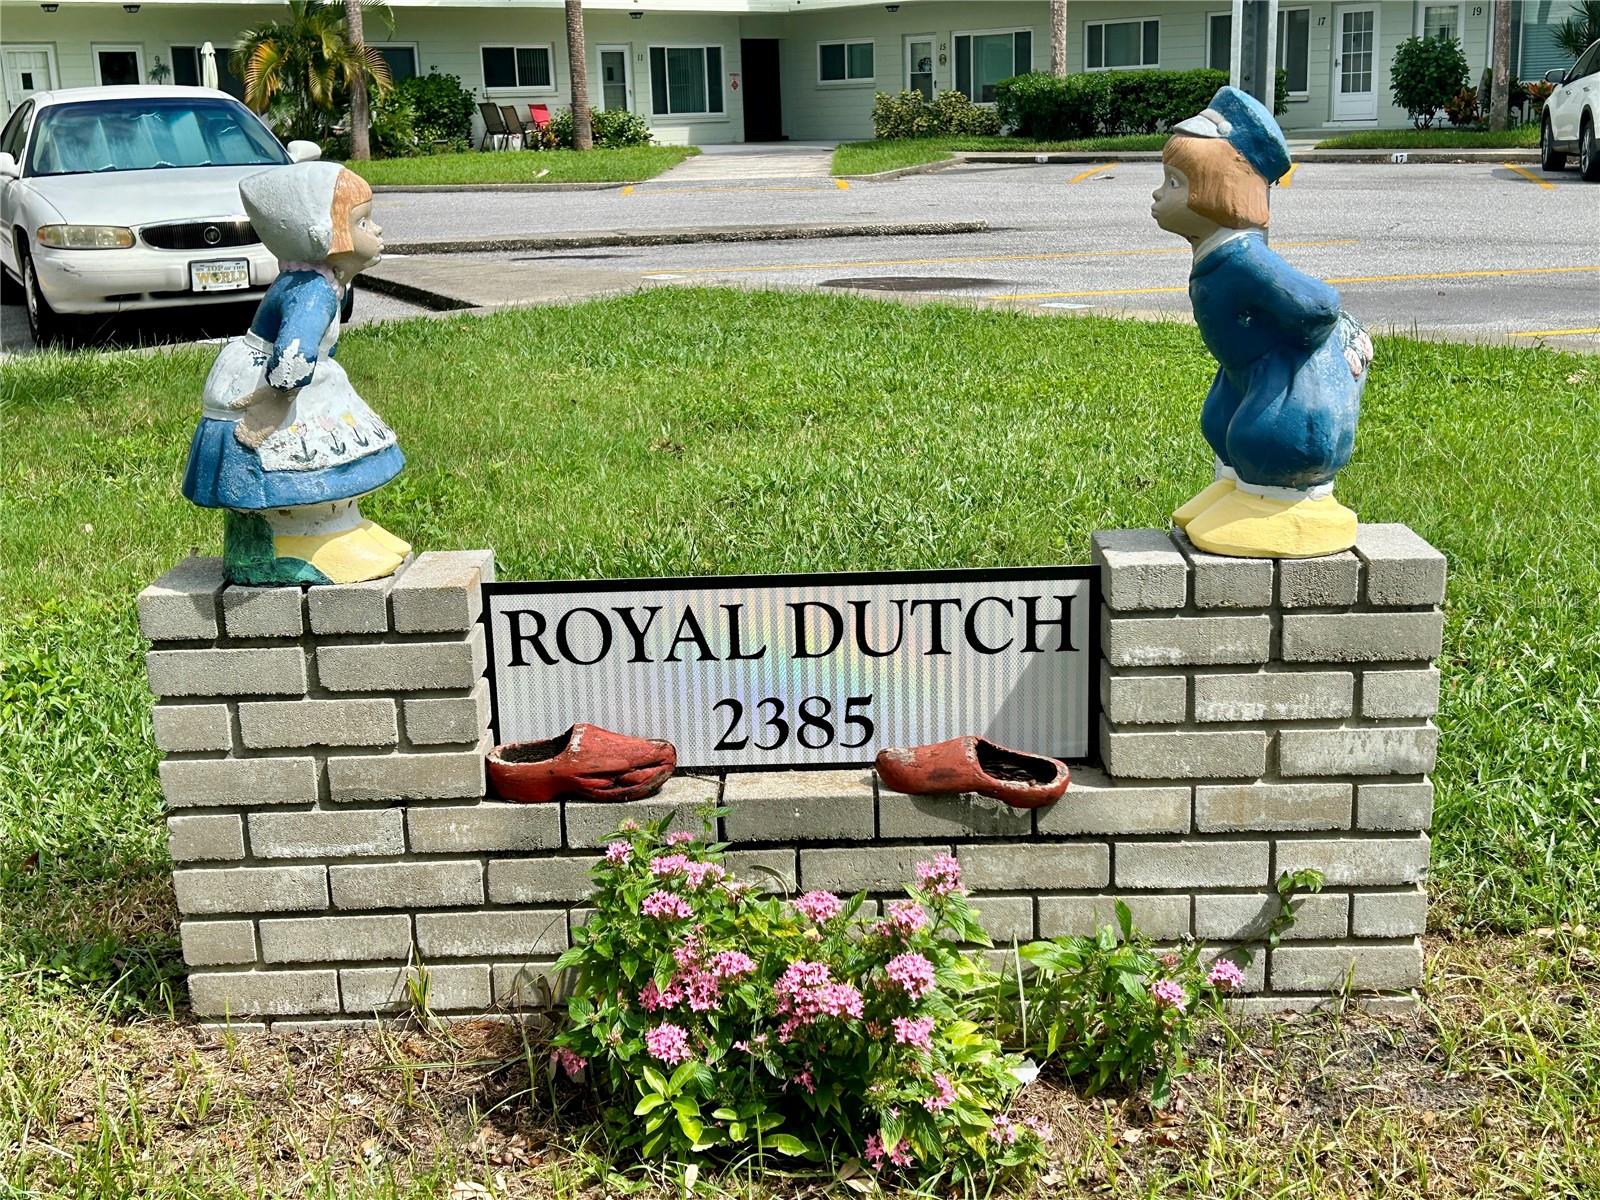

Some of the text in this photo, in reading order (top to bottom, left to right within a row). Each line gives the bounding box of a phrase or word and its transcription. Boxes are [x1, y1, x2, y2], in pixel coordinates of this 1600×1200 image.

[1472, 7, 1482, 16] 19
[1317, 17, 1326, 25] 17
[154, 55, 160, 64] 9
[1395, 155, 1404, 163] 17
[195, 270, 247, 284] WORLD
[500, 594, 1080, 667] ROYAL DUTCH
[712, 694, 876, 752] 2385
